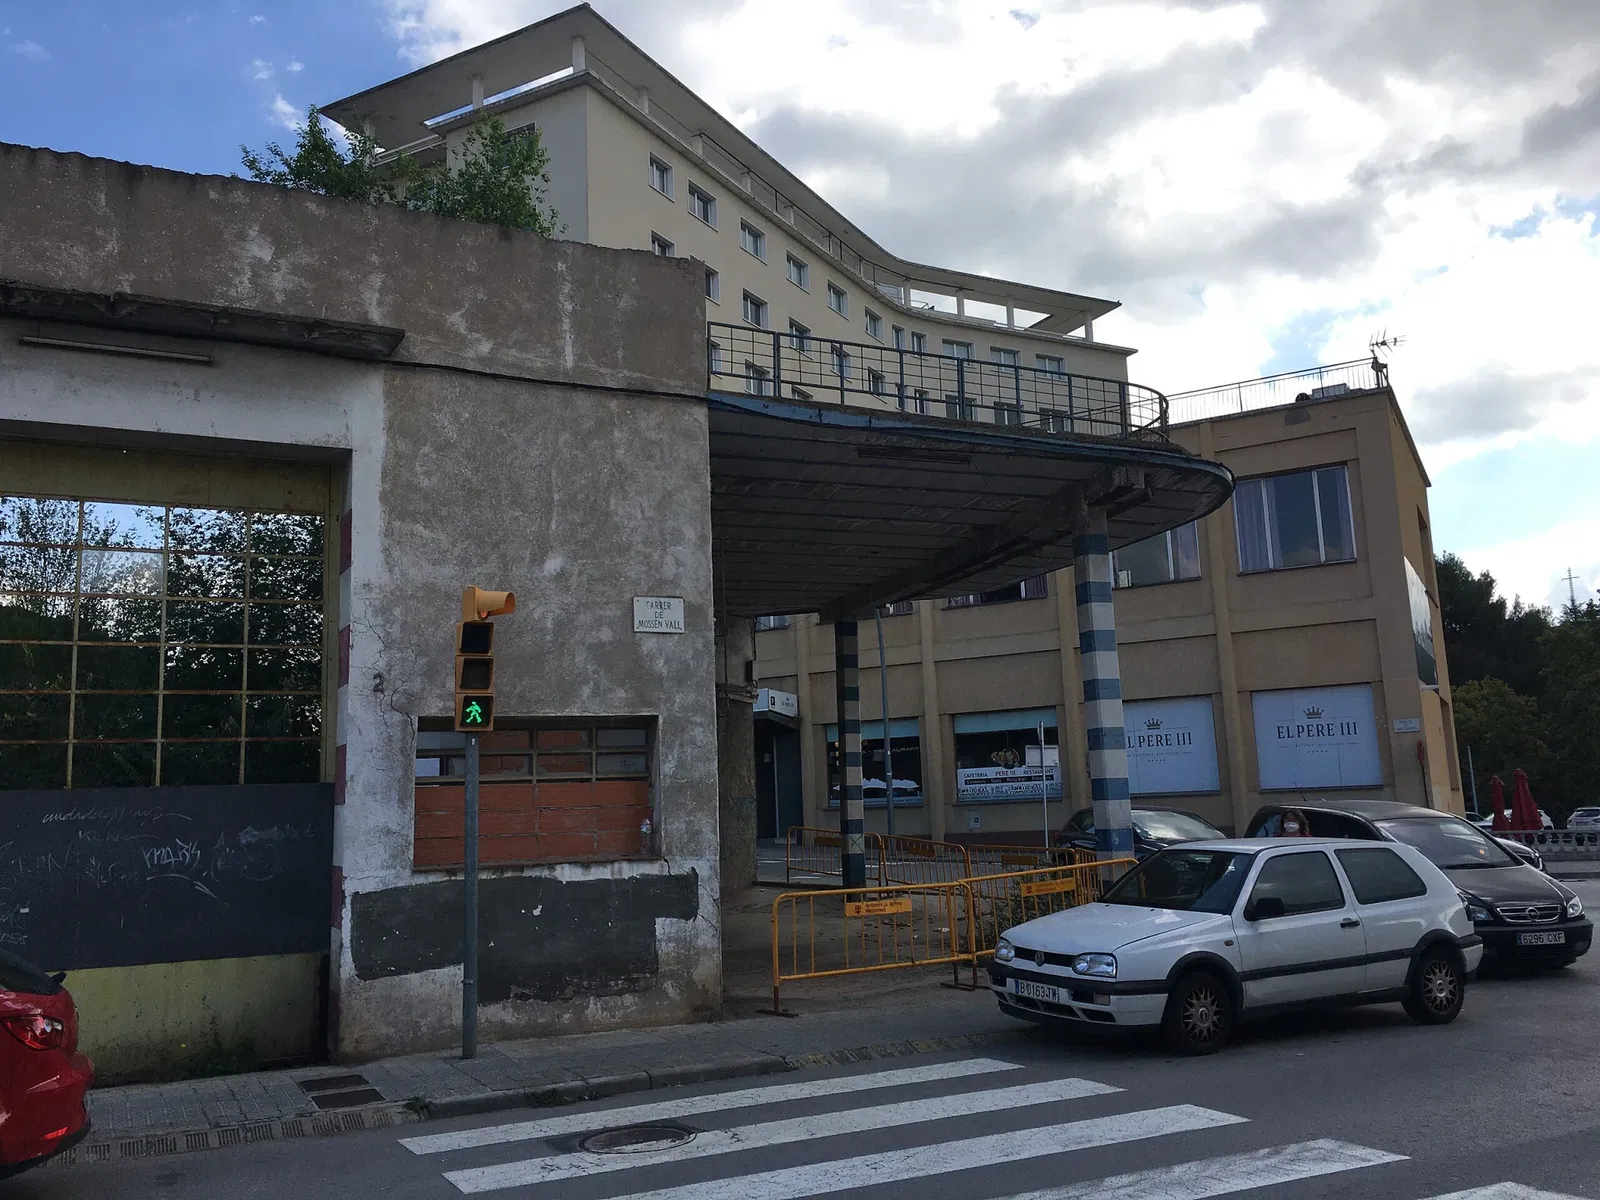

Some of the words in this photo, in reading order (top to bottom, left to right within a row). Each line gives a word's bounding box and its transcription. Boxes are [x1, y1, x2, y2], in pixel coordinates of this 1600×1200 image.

[646, 601, 672, 610] CARRER
[654, 611, 664, 619] DE
[664, 620, 681, 630] VALL
[1277, 725, 1294, 739] EL
[1296, 723, 1335, 738] PERE
[1340, 721, 1358, 736] III
[1127, 736, 1135, 749] L
[1138, 733, 1172, 748] PERE
[1176, 732, 1192, 746] III
[1522, 934, 1544, 944] 6296
[1547, 932, 1562, 943] CXF
